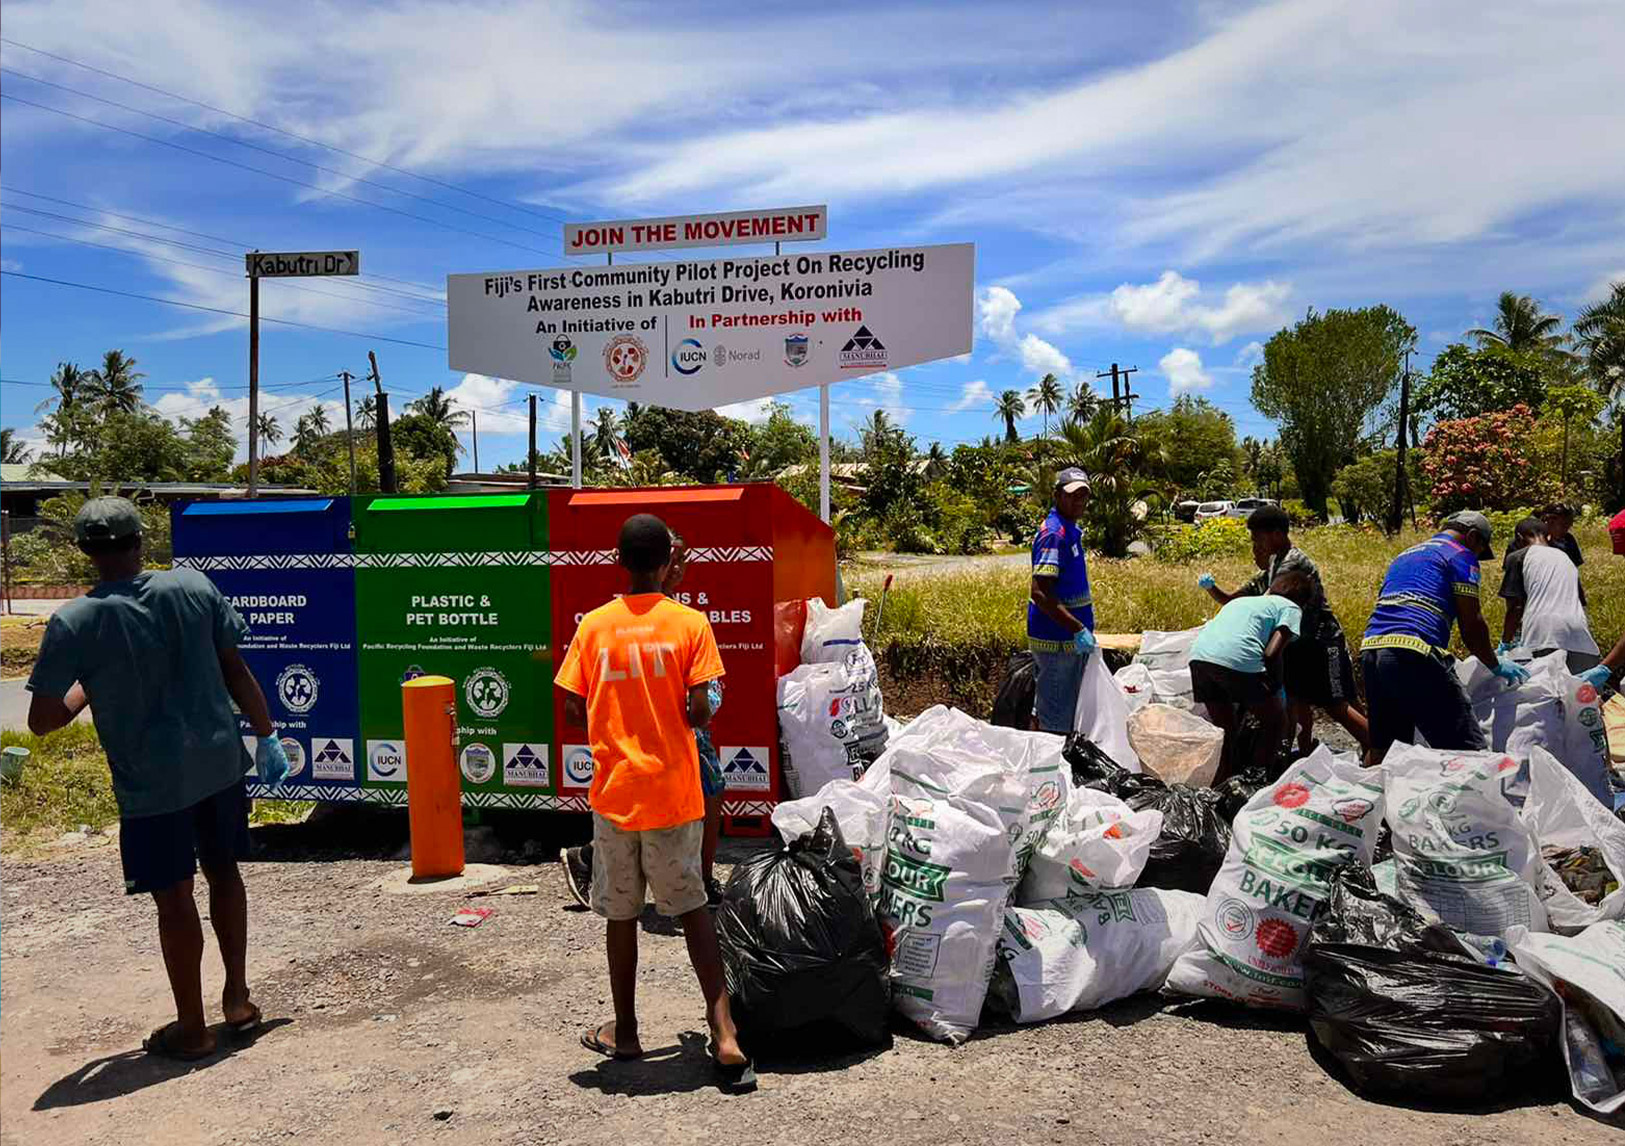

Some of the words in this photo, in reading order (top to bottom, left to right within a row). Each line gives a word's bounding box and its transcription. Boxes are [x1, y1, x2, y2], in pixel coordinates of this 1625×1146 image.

[572, 227, 624, 247] JOIN
[631, 224, 676, 243] THE
[685, 214, 820, 240] MOVEMENT
[252, 254, 319, 275] Kabutri
[324, 255, 344, 273] Dr
[484, 276, 522, 298] Fiji's
[528, 272, 567, 291] First
[571, 265, 670, 290] Community
[676, 263, 717, 281] Pilot
[723, 259, 790, 282] Project
[797, 256, 822, 274] On
[829, 251, 925, 276] Recycling
[527, 295, 621, 312] Awareness
[627, 291, 643, 308] in
[649, 286, 716, 306] Kabutri
[722, 284, 774, 304] Drive,
[781, 278, 873, 301] Koronivia
[689, 314, 706, 328] In
[711, 309, 816, 328] Partnership
[821, 308, 863, 323] with
[535, 321, 557, 334] An
[562, 319, 635, 333] Initiative
[640, 316, 658, 330] of
[680, 352, 706, 362] IUCN
[728, 349, 760, 361] Norad
[411, 595, 475, 607] PLASTIC
[479, 595, 491, 607] &
[697, 592, 709, 605] &
[250, 612, 295, 624] PAPER
[406, 613, 434, 625] PET
[438, 613, 499, 625] BOTTLE
[288, 721, 306, 729] with
[477, 726, 497, 735] with
[377, 755, 402, 765] IUCN
